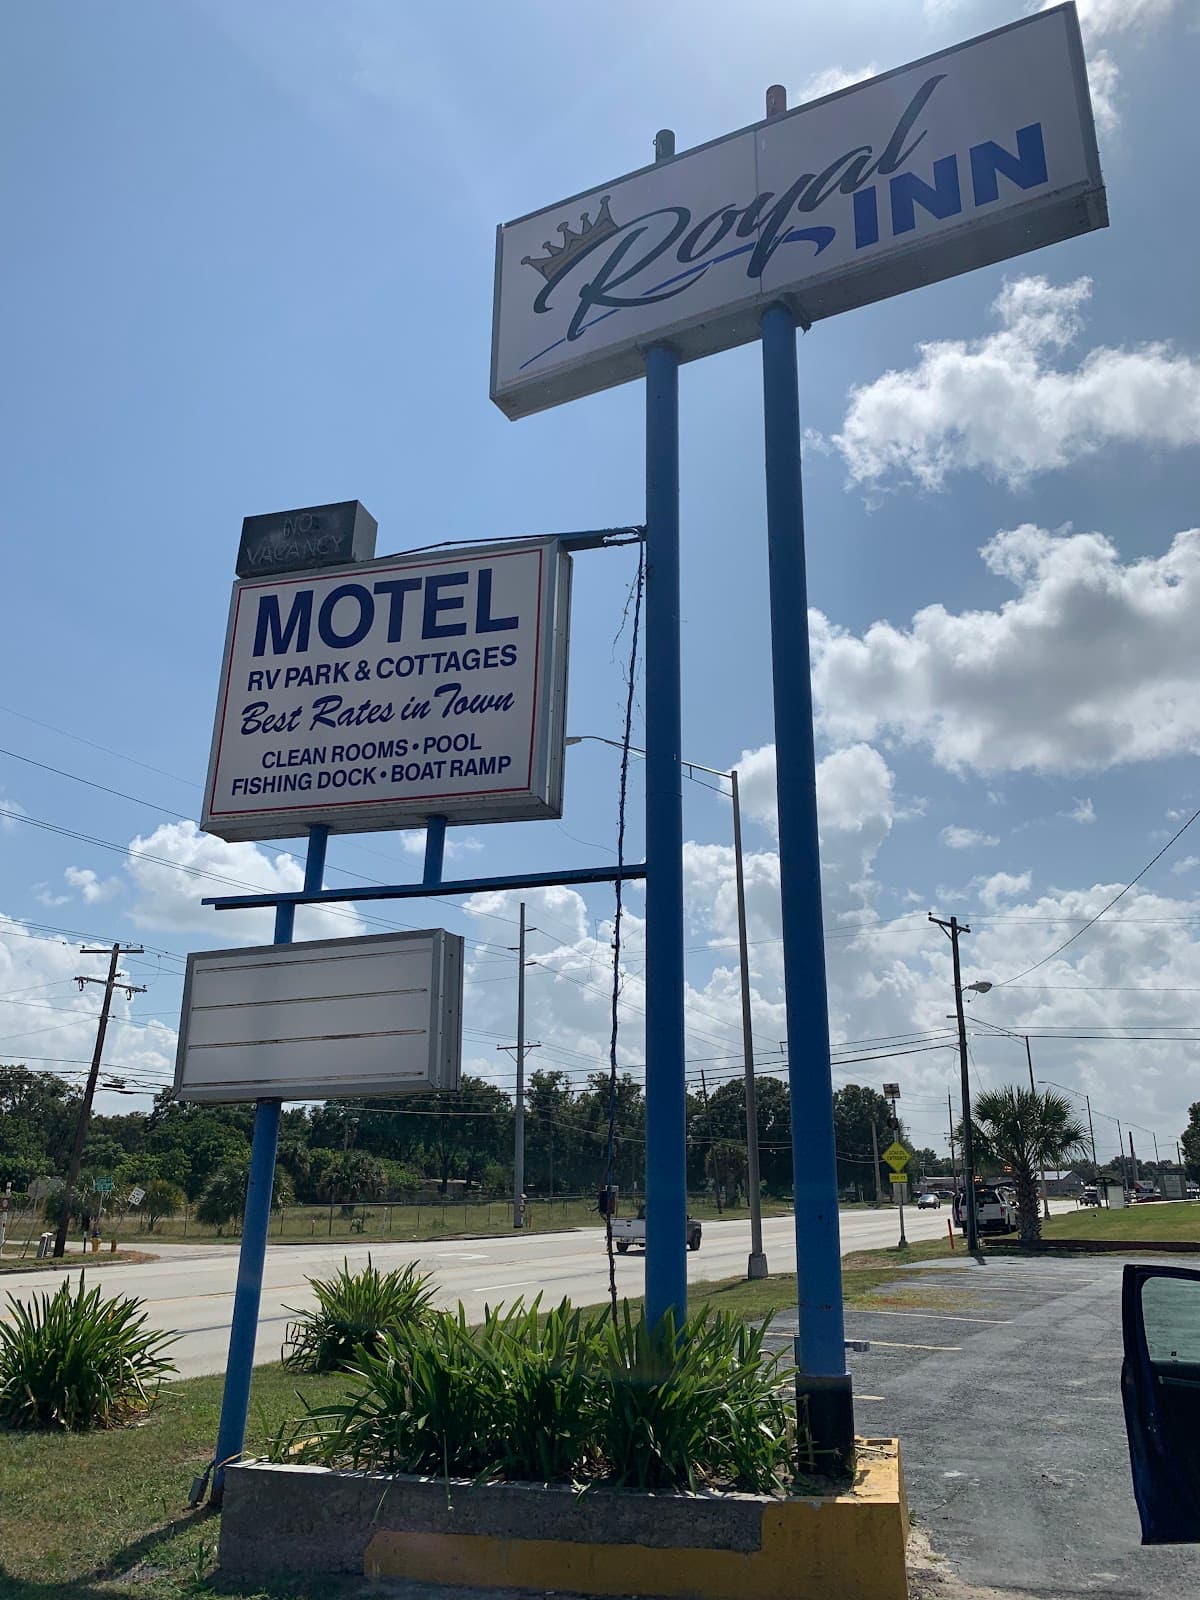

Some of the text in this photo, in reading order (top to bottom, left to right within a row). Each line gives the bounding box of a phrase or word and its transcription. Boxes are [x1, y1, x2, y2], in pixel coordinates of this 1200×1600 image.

[533, 74, 948, 342] Royal
[853, 122, 1049, 250] INN
[283, 513, 313, 537] NO
[246, 535, 342, 566] VACANCY
[252, 568, 519, 658] MOTEL
[247, 644, 518, 692] RV PARK & COTTAGES
[240, 682, 515, 736] Best Rates in Town
[262, 732, 482, 769] CLEAN ROOMS POOL
[231, 755, 512, 796] FISHING DOCK BOAT RAMP
